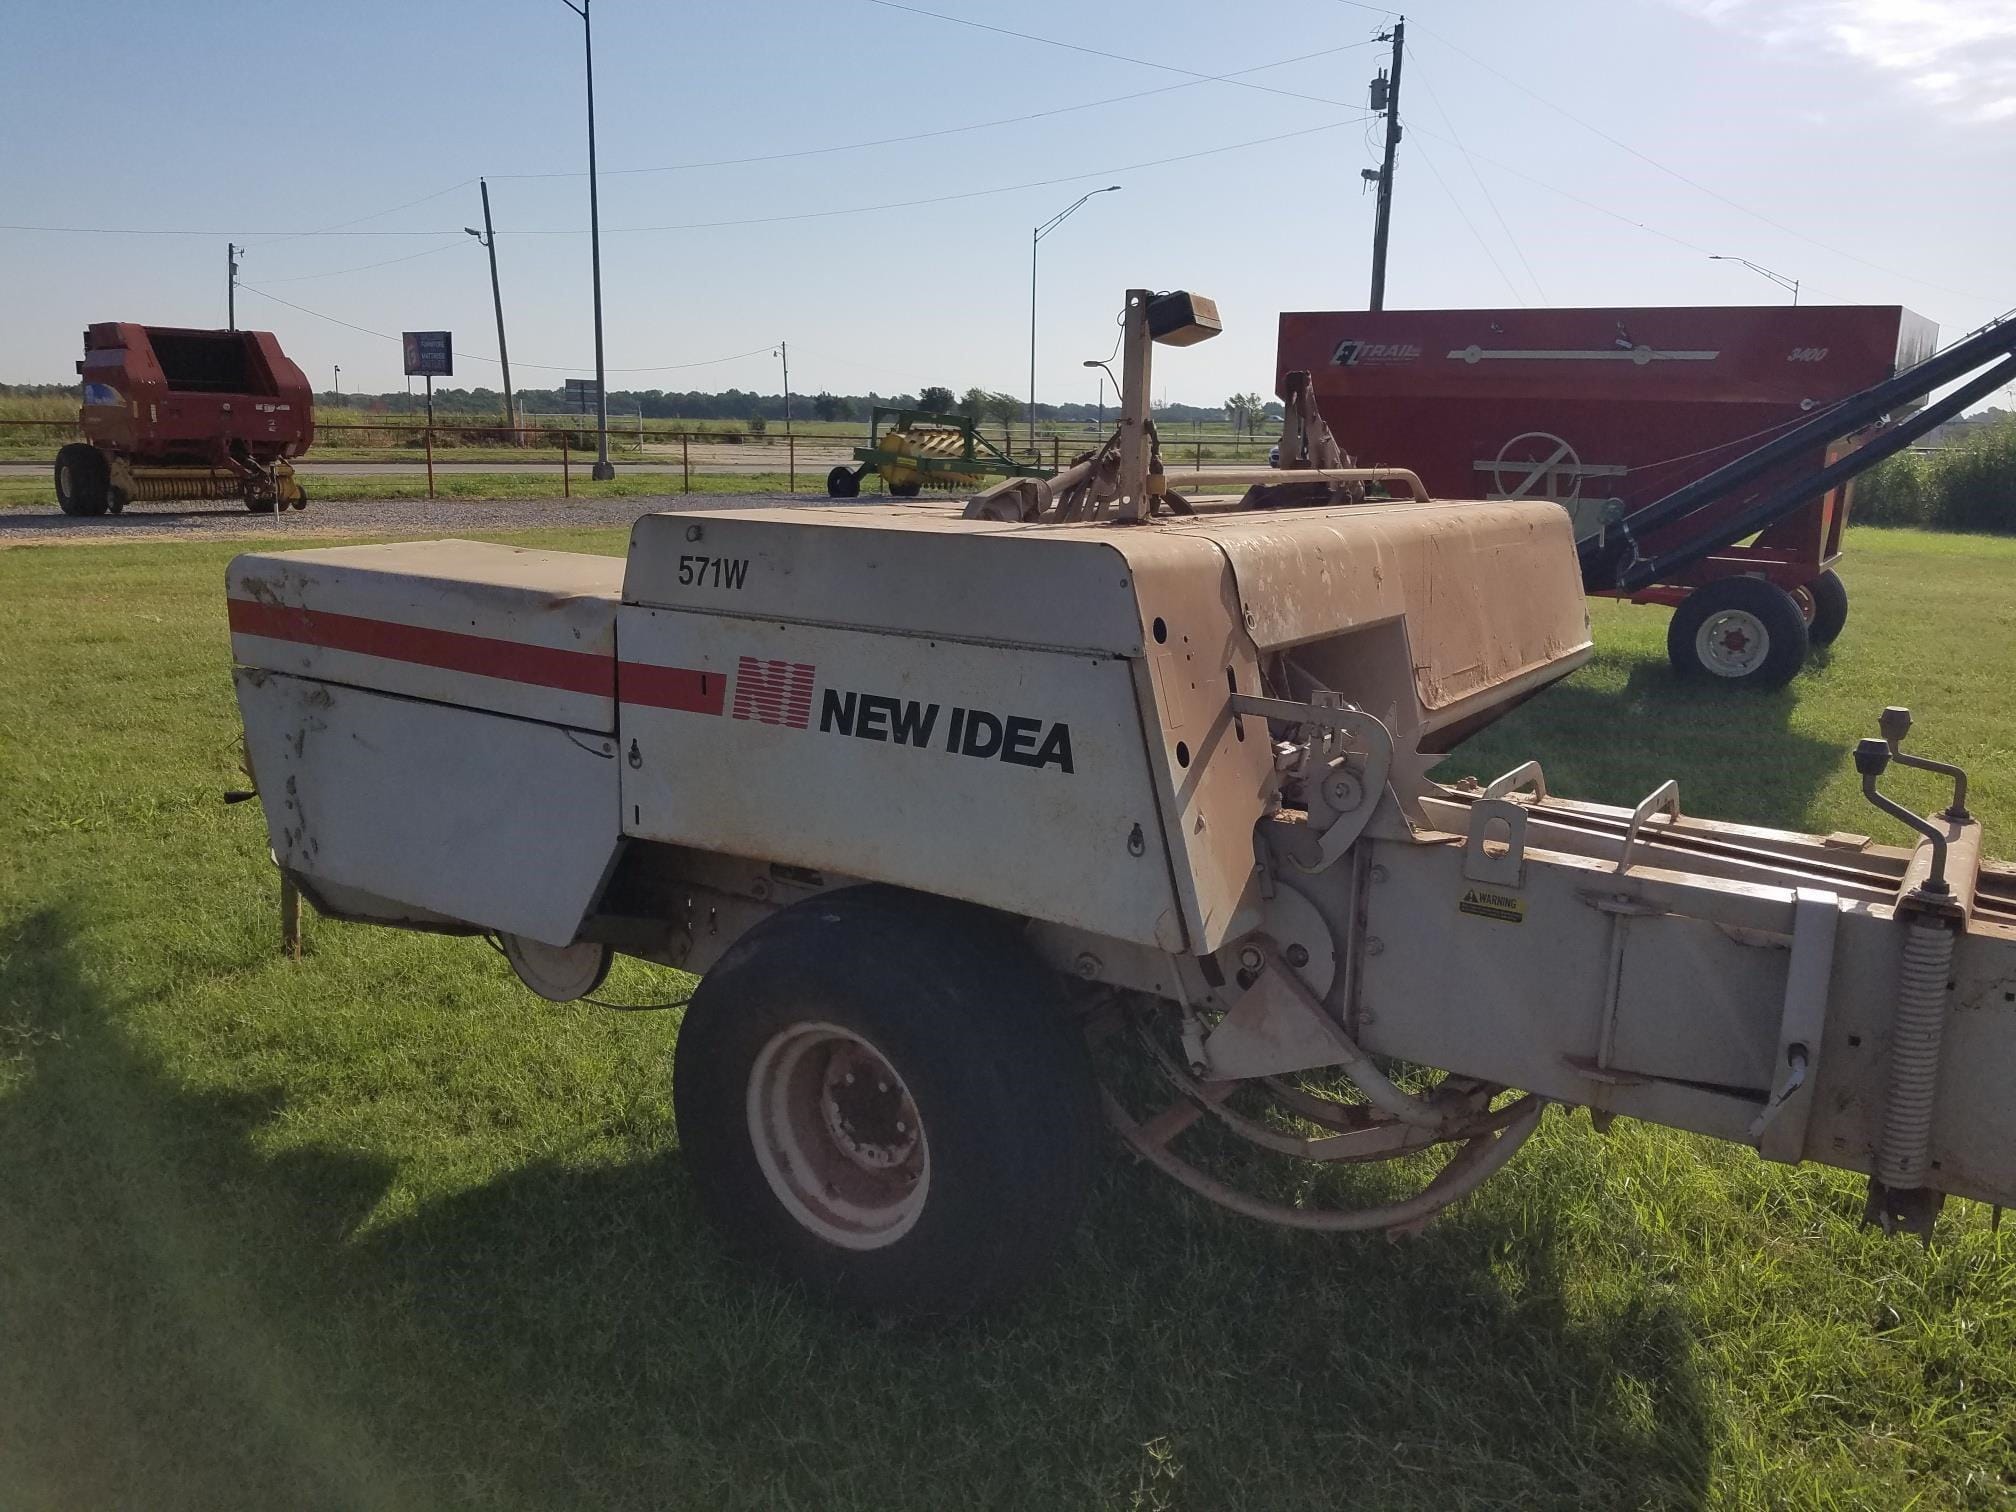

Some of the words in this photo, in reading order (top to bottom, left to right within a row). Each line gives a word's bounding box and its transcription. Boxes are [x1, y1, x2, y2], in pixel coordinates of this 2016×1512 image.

[1361, 344, 1420, 357] TRAIL
[678, 555, 749, 590] 571W
[819, 688, 940, 749] NEW
[945, 707, 1075, 774] IDEA
[1479, 892, 1518, 909] WARNING
